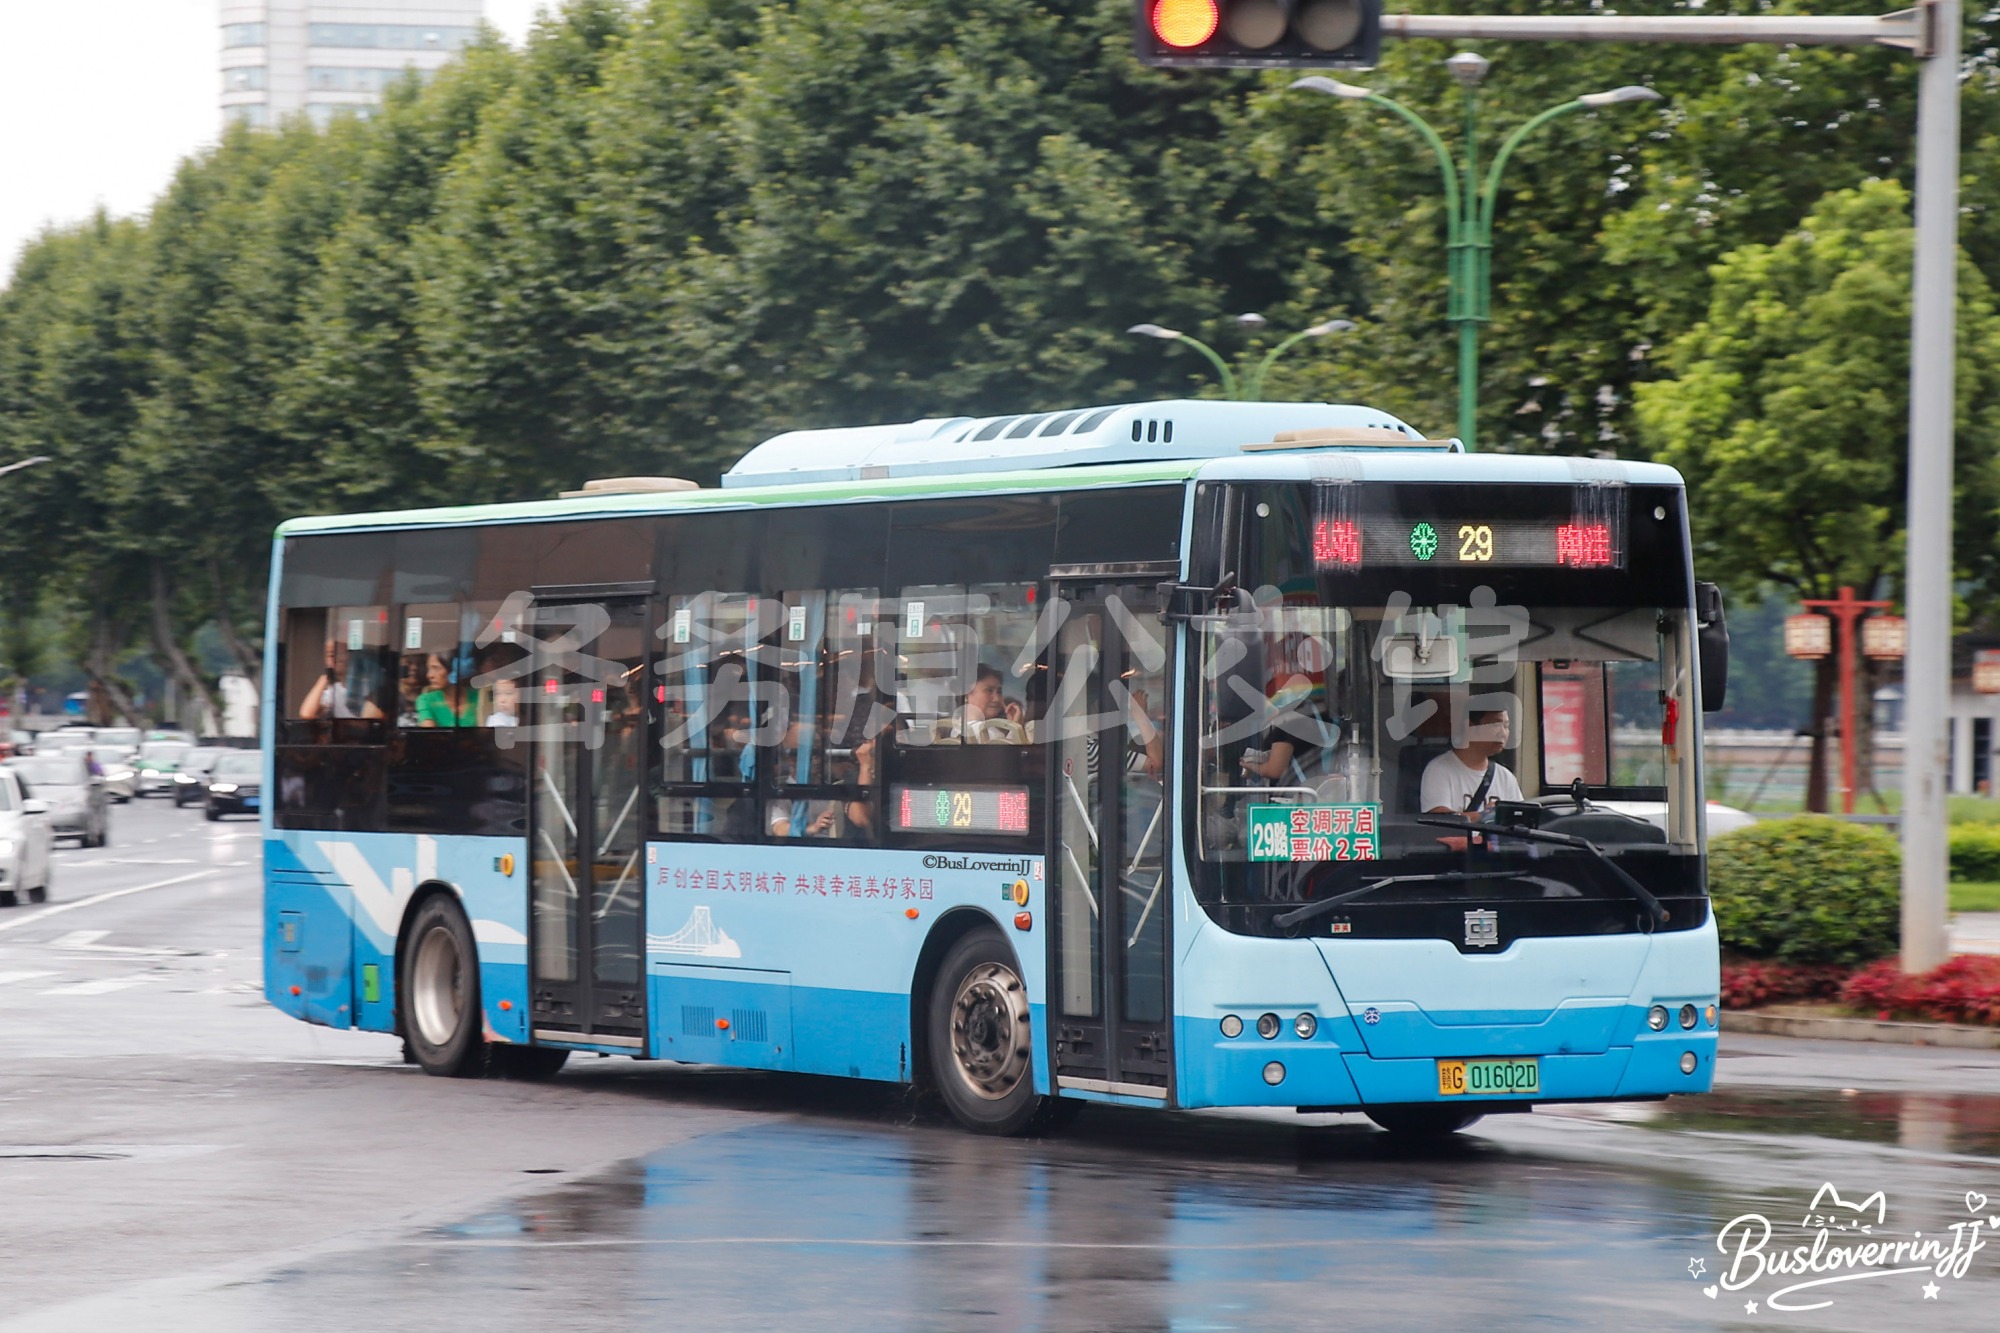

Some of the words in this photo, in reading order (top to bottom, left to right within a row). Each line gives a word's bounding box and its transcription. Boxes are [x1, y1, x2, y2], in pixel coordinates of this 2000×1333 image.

[1458, 525, 1493, 561] 29
[953, 792, 973, 828] 29
[1290, 808, 1374, 835] 空调开启
[1253, 822, 1289, 858] 29路
[1290, 837, 1374, 861] 票价2元
